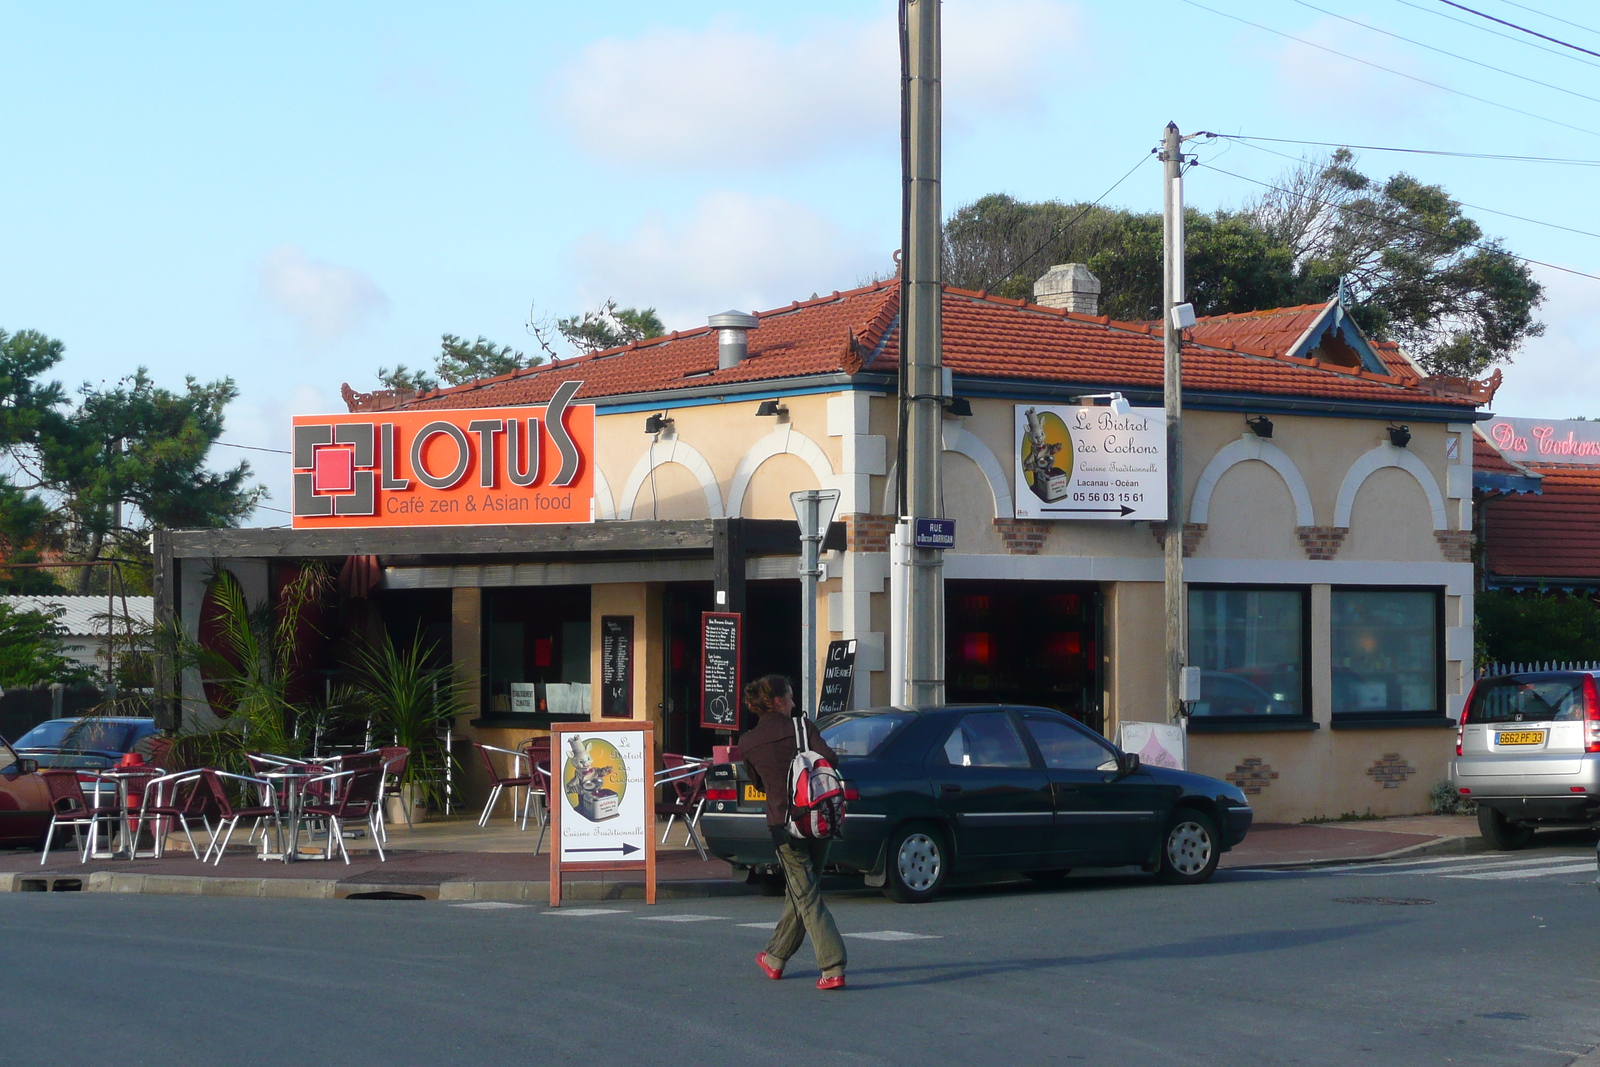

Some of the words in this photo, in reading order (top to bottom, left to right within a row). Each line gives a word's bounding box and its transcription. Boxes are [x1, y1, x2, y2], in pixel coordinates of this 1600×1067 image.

[1072, 411, 1092, 431] Le
[1098, 411, 1149, 432] Bistrot
[380, 380, 584, 490] LOTUS
[1492, 423, 1528, 451] Des
[1533, 426, 1600, 456] Cochons
[1078, 440, 1098, 453] des
[1103, 434, 1159, 454] Cochons
[1080, 461, 1106, 473] Cuisine
[1109, 461, 1158, 473] Traditionnelle
[1077, 479, 1109, 488] Lacanau
[1115, 479, 1139, 488] Océan
[1073, 492, 1086, 502] 05
[1088, 492, 1100, 502] 56
[1103, 492, 1115, 502] 03
[1118, 492, 1130, 502] 15
[1132, 492, 1144, 502] 61
[386, 495, 424, 514] Café
[430, 500, 459, 512] zen
[465, 497, 476, 511] &
[483, 495, 529, 511] Asian
[534, 493, 571, 510] food
[930, 524, 942, 532] RUE
[1500, 734, 1520, 743] 6662
[1520, 733, 1530, 742] PF
[1532, 732, 1543, 742] 33
[563, 827, 590, 837] Cuisine
[593, 826, 643, 837] Traditionnelle
